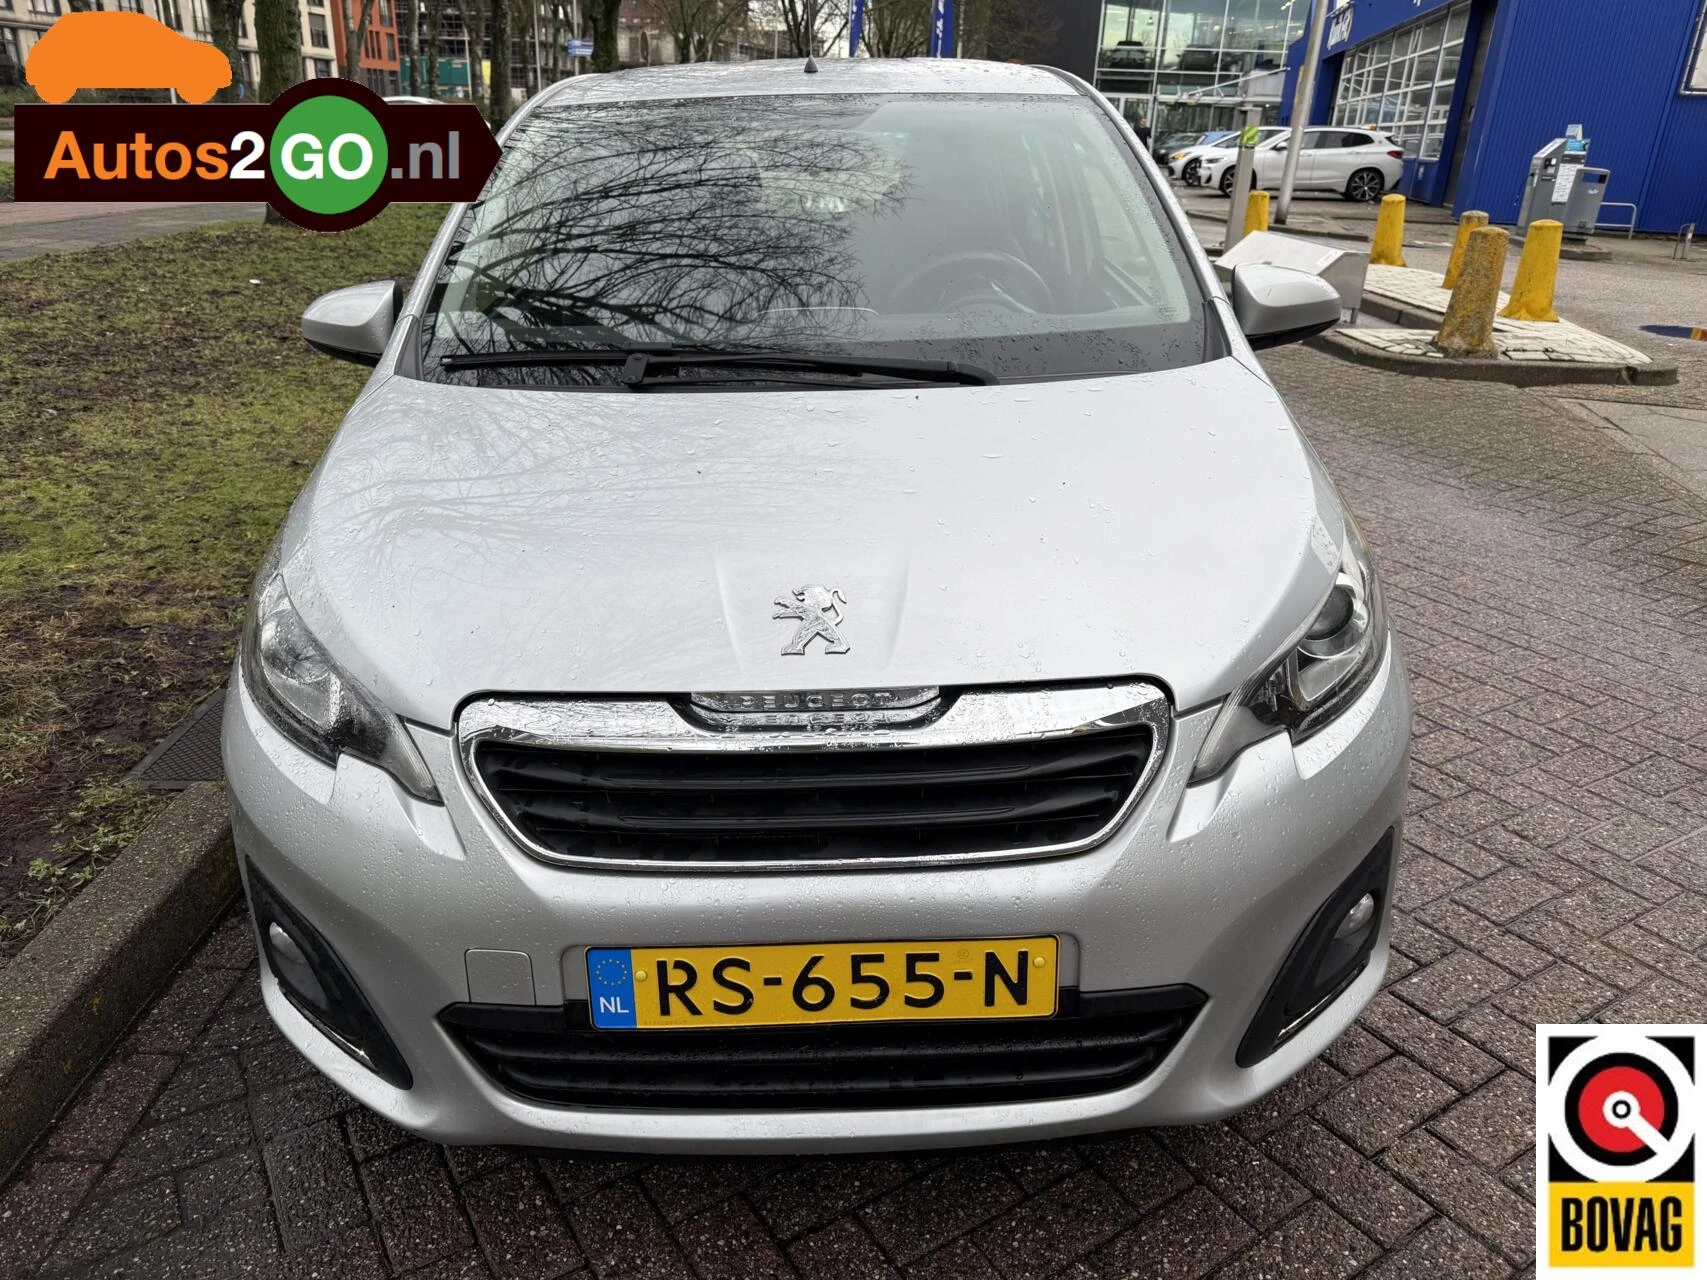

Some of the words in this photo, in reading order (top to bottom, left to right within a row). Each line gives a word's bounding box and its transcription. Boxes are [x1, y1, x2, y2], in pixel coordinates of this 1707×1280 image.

[739, 692, 894, 709] PEUGEOT
[656, 949, 1029, 1017] RS-655-N
[599, 995, 630, 1015] NL
